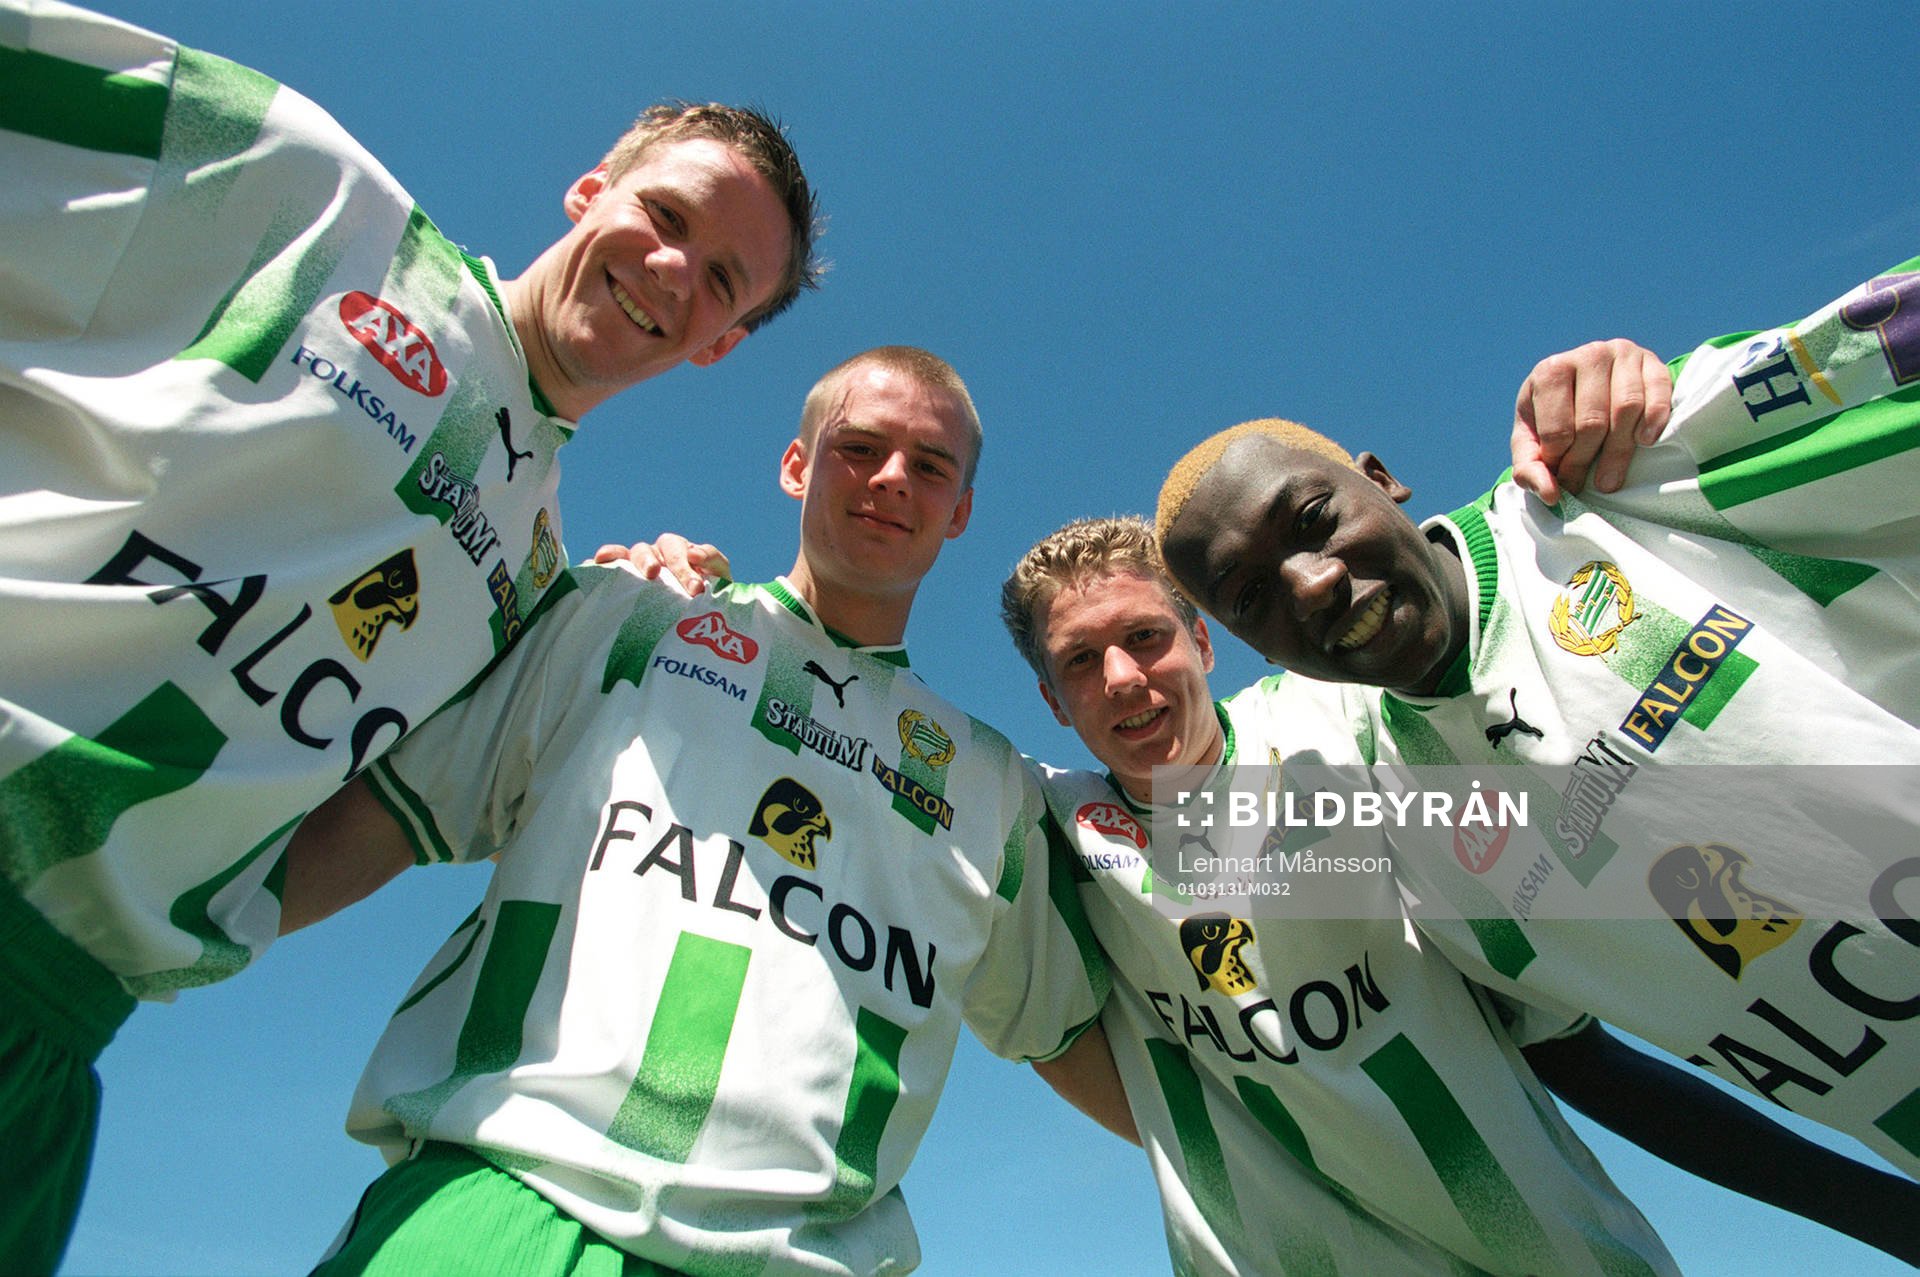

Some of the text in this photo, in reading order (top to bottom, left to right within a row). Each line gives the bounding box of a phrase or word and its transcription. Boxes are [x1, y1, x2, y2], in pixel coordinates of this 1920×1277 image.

[348, 305, 433, 392] AXA
[291, 345, 417, 454] FOLKSAM
[652, 656, 747, 702] FOLKSAM
[683, 615, 747, 663] AXA
[1624, 612, 1748, 743] FALCON
[766, 697, 867, 772] STADIUM
[874, 757, 953, 828] FALCON
[1082, 806, 1138, 841] AXA
[1553, 738, 1639, 859] STADIUM
[589, 800, 937, 1009] FALCON
[1145, 949, 1391, 1065] FALCON
[1685, 856, 1920, 1112] ALC
